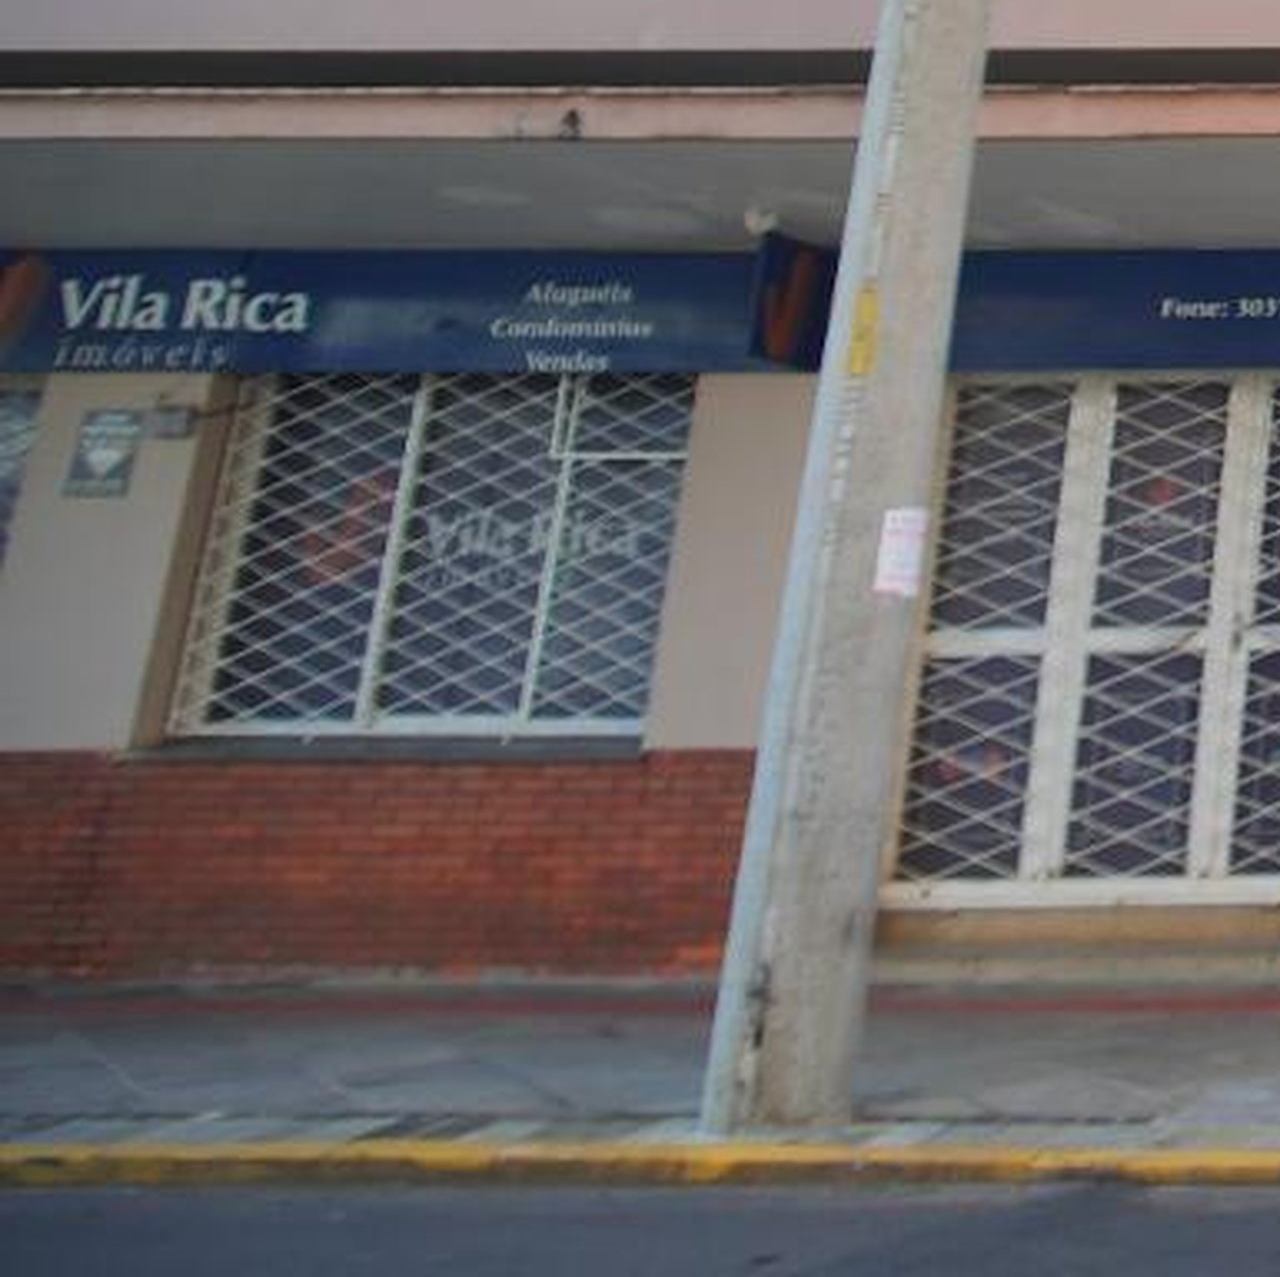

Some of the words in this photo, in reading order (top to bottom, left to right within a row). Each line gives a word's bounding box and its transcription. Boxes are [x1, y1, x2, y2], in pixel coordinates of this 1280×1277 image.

[60, 275, 168, 330] Vila
[181, 276, 311, 332] Rica
[1160, 297, 1229, 320] Fone:
[53, 335, 229, 367] imóveis
[526, 350, 611, 374] Vendas
